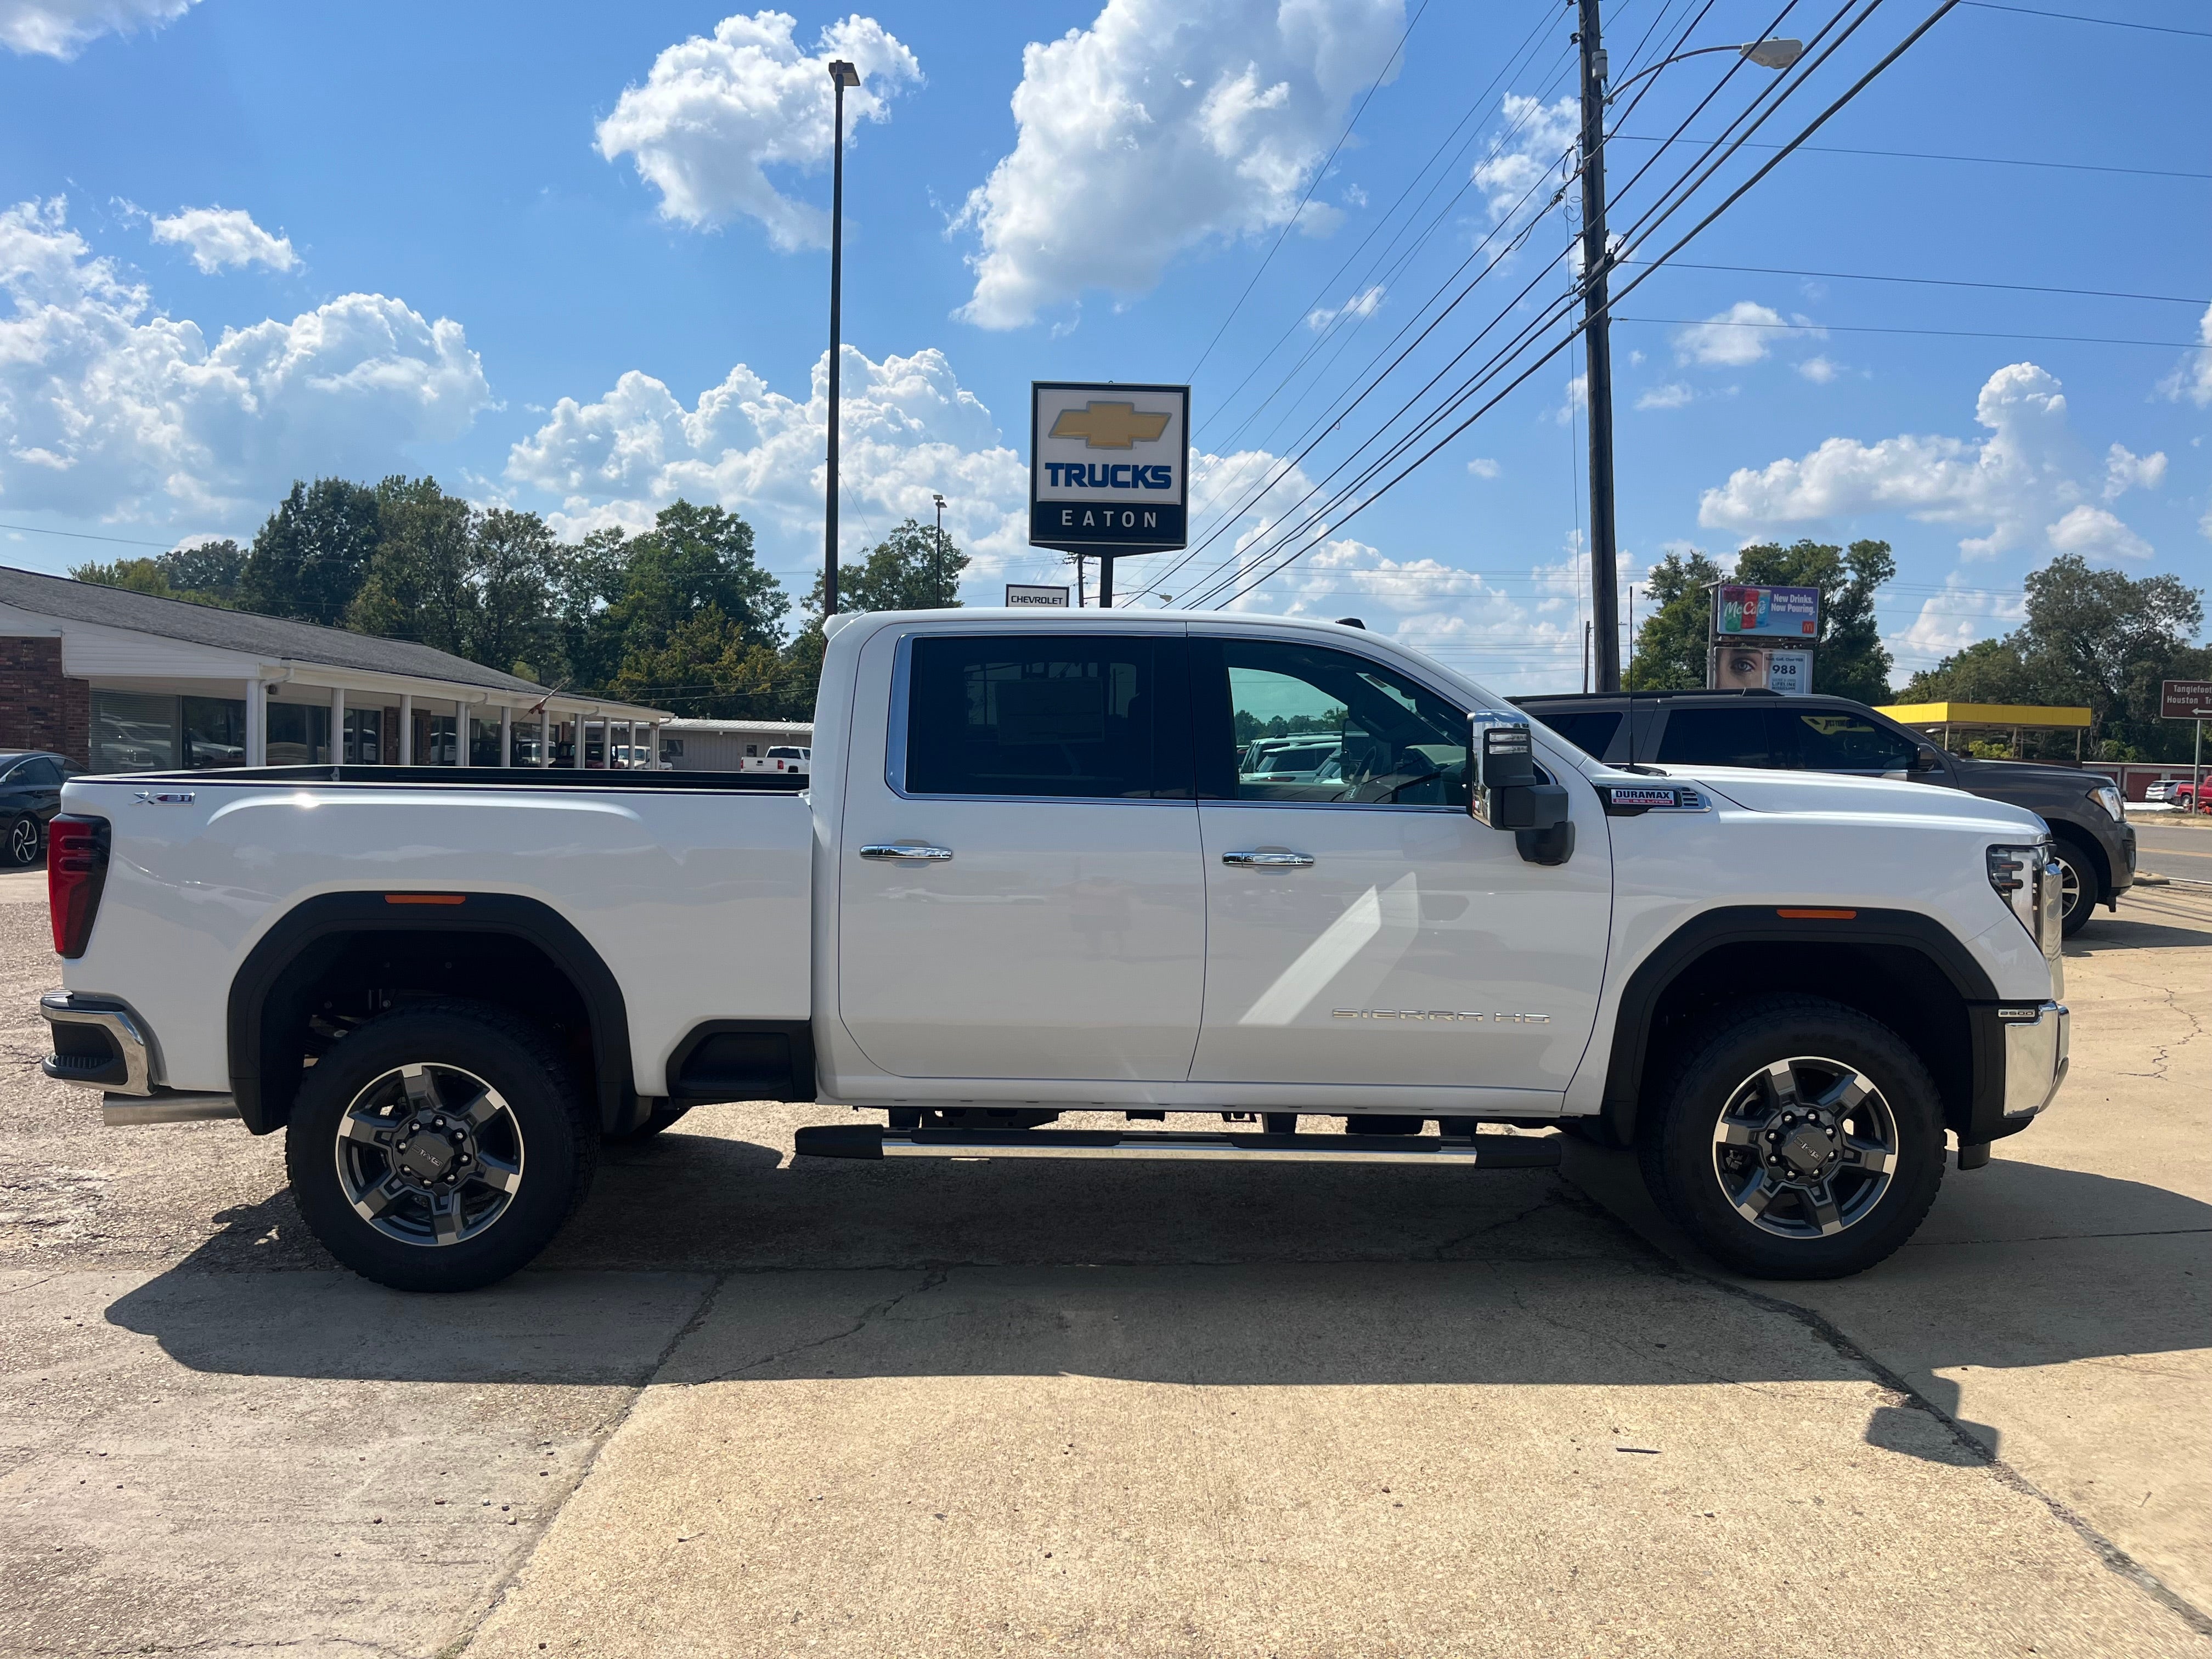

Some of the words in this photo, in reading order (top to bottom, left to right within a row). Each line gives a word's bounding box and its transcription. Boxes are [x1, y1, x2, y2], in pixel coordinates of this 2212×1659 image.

[1045, 462, 1171, 489] TRUCKS
[1062, 510, 1156, 528] EATON
[1011, 595, 1063, 605] CHEVROLET
[1774, 594, 1788, 602] New
[1790, 594, 1813, 603] Drinks.
[1771, 603, 1786, 612] Now
[1787, 603, 1815, 616] Pouring.
[1773, 665, 1796, 674] 988
[2174, 685, 2212, 695] Tanglefoot
[2167, 695, 2198, 704] Houston
[1615, 790, 1670, 799] DURAMAX
[1332, 1008, 1483, 1022] SIERRA
[1494, 1012, 1550, 1023] HD
[1793, 1136, 1822, 1163] GMC
[411, 1143, 443, 1168] GMC
